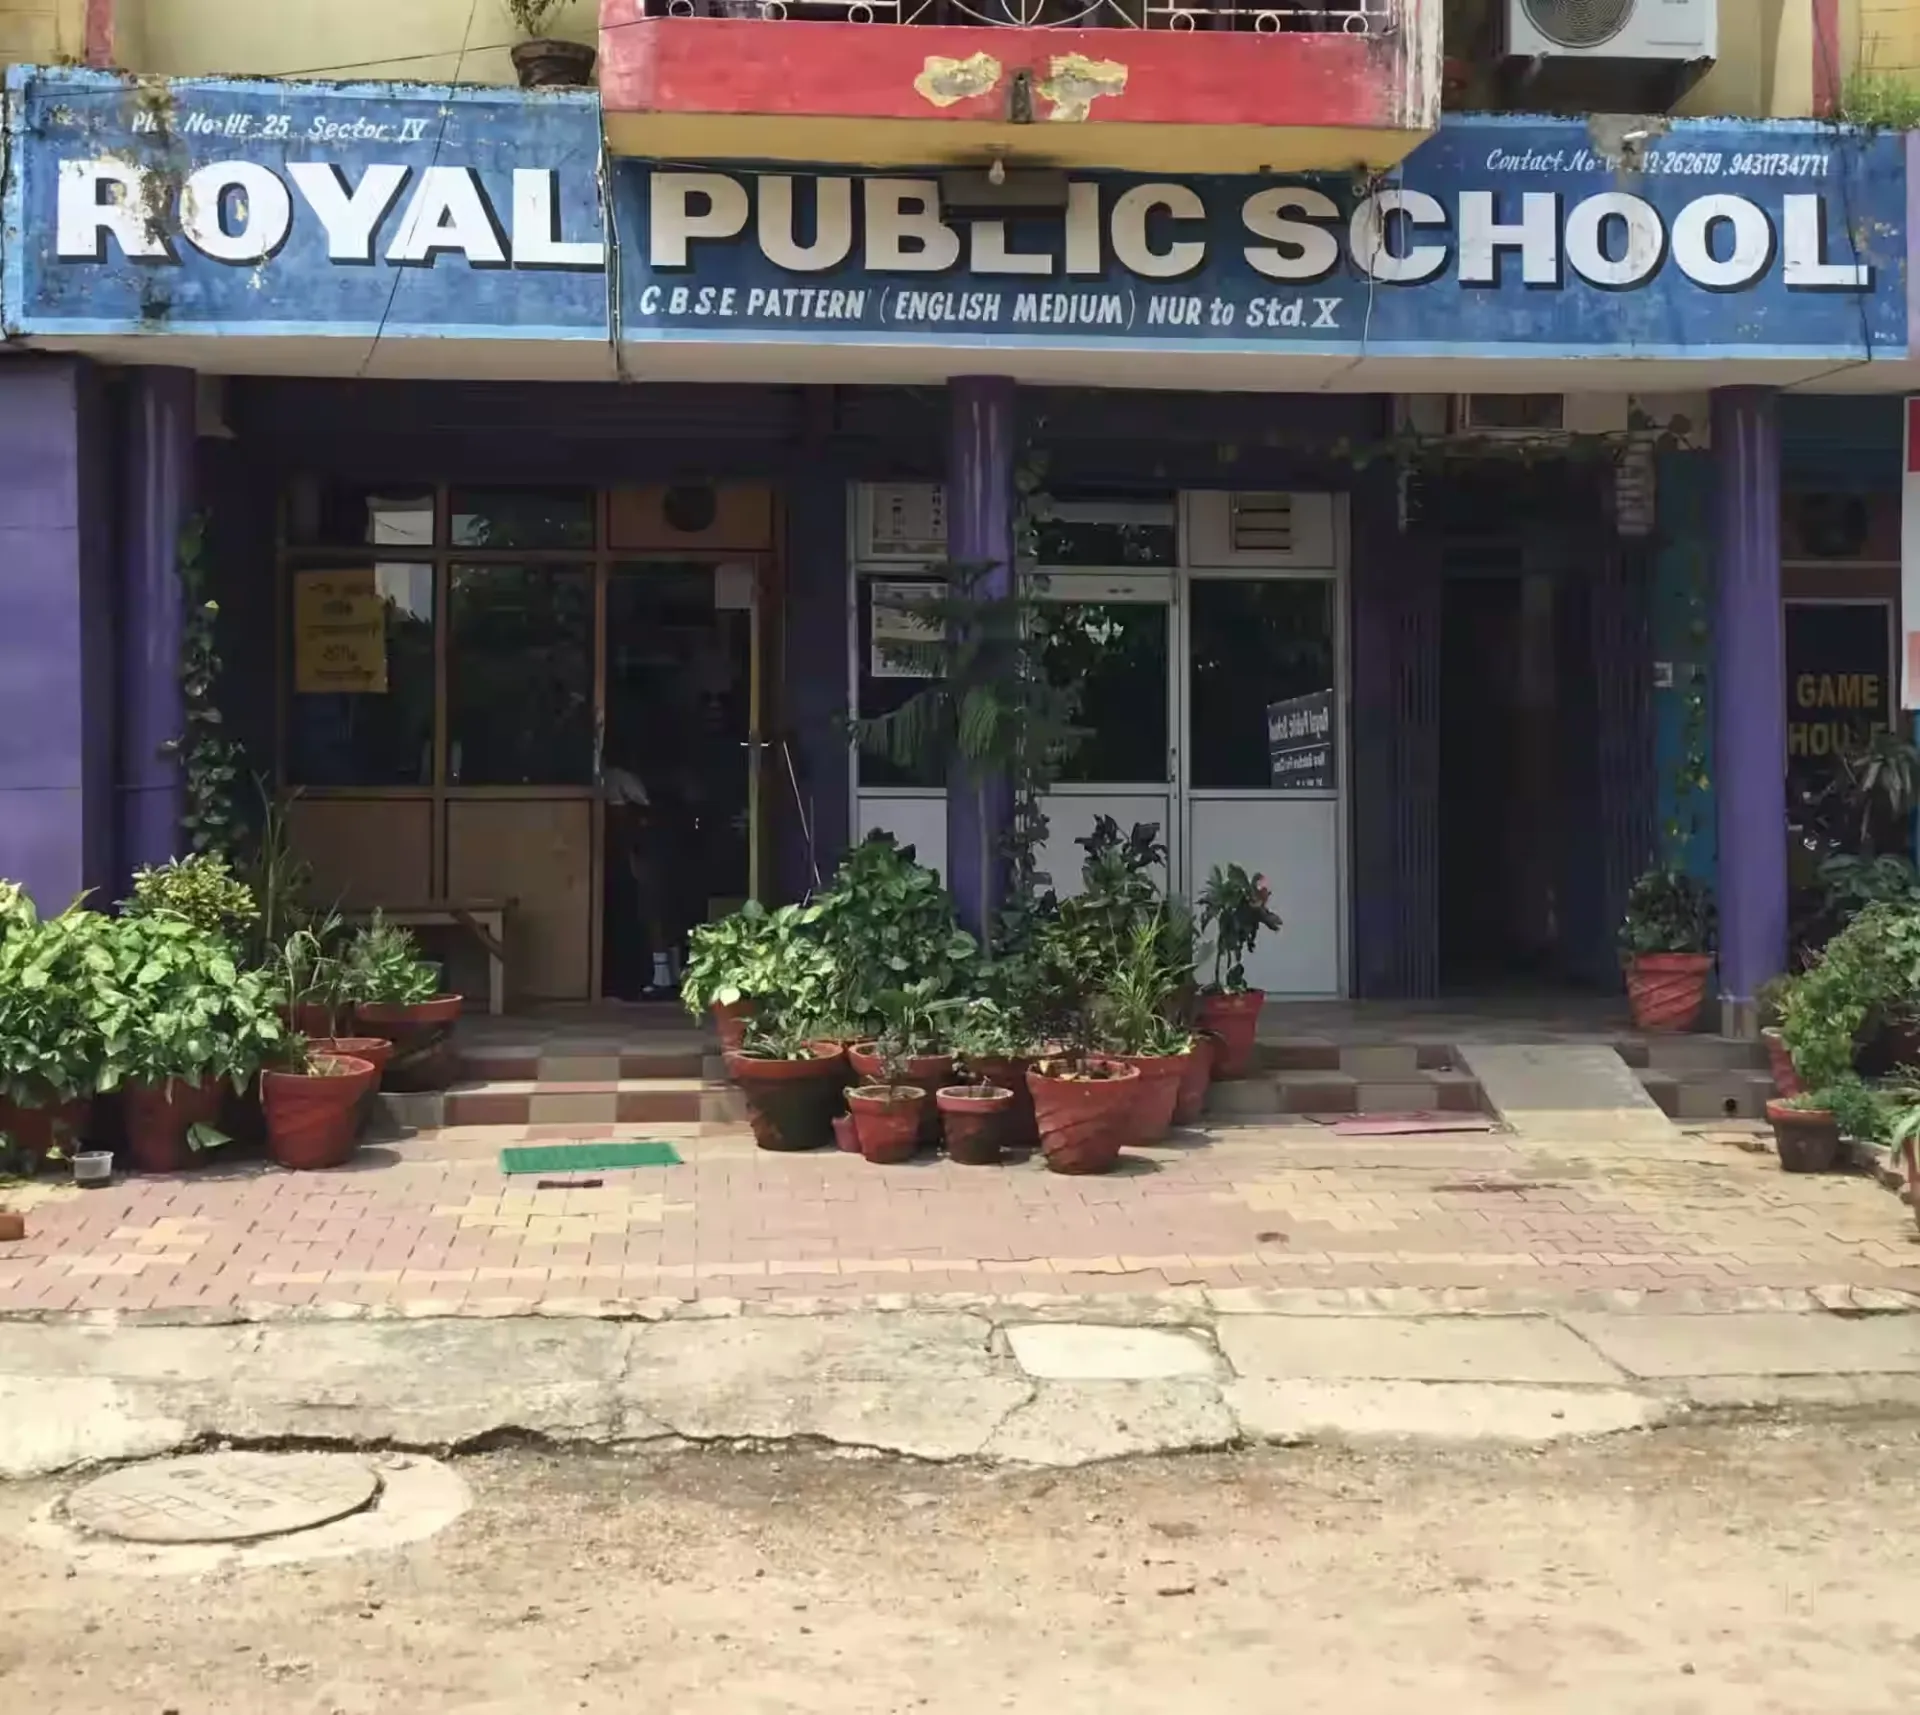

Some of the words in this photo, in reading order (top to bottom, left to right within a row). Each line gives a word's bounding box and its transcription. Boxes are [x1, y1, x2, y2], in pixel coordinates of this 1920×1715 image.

[1486, 148, 1563, 174] Contact
[57, 159, 605, 266] ROYAL
[649, 171, 1207, 279] PUBLIC
[1242, 187, 1869, 287] SCHOOL
[747, 287, 866, 319] PATTERN
[1148, 299, 1200, 327] NUR
[1210, 301, 1234, 327] to
[1796, 673, 1879, 708] GAME
[1788, 721, 1887, 757] HOUE
